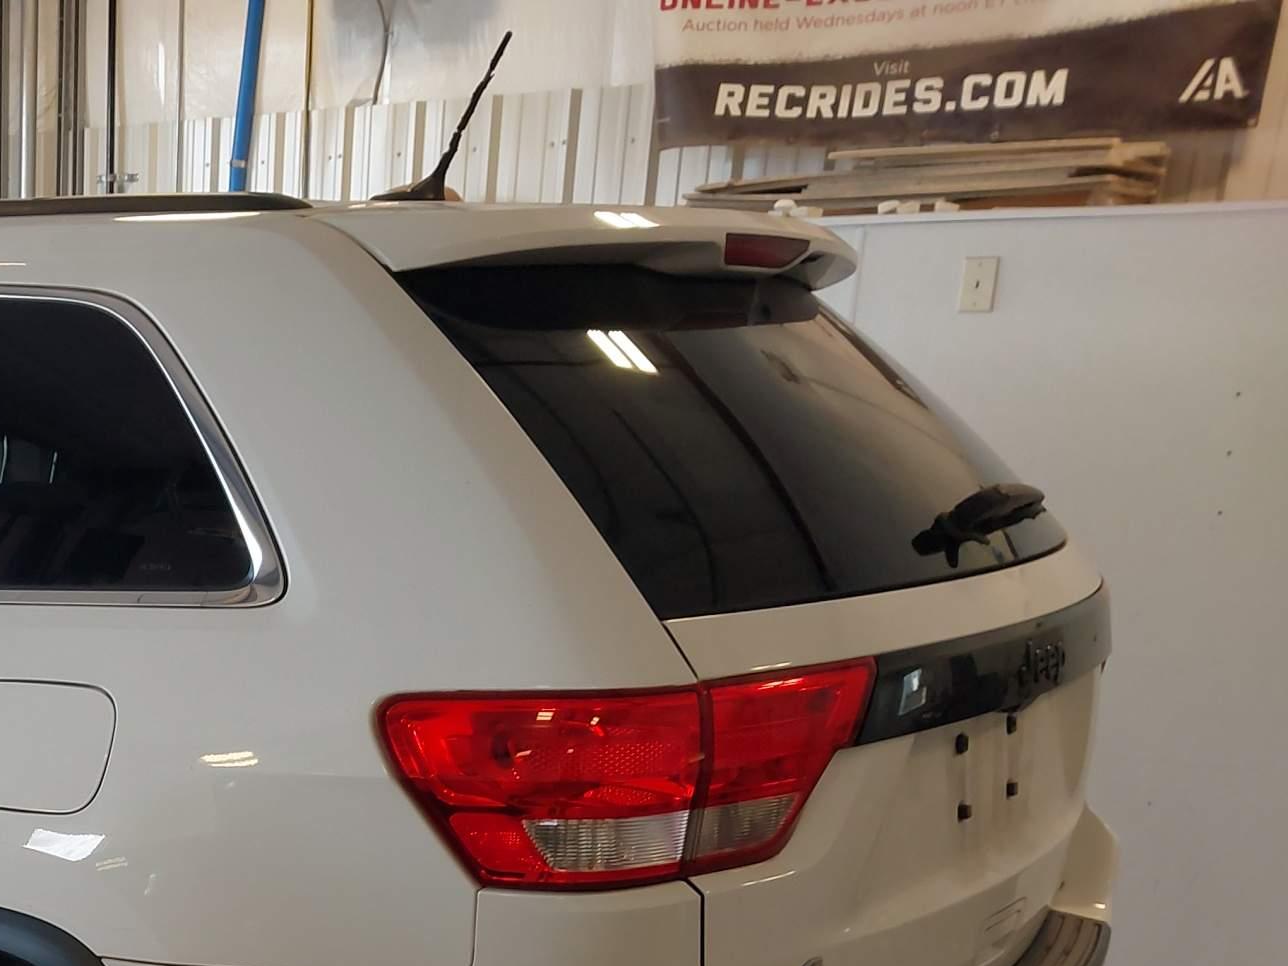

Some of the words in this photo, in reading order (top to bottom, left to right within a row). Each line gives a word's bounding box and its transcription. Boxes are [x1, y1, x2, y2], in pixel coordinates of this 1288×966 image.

[682, 18, 748, 33] Auction
[753, 17, 790, 31] held
[796, 9, 905, 30] Wednesdays
[910, 4, 927, 18] at
[932, 1, 978, 16] noon
[873, 60, 910, 76] Visit
[714, 68, 1070, 119] RECRIDES.COM
